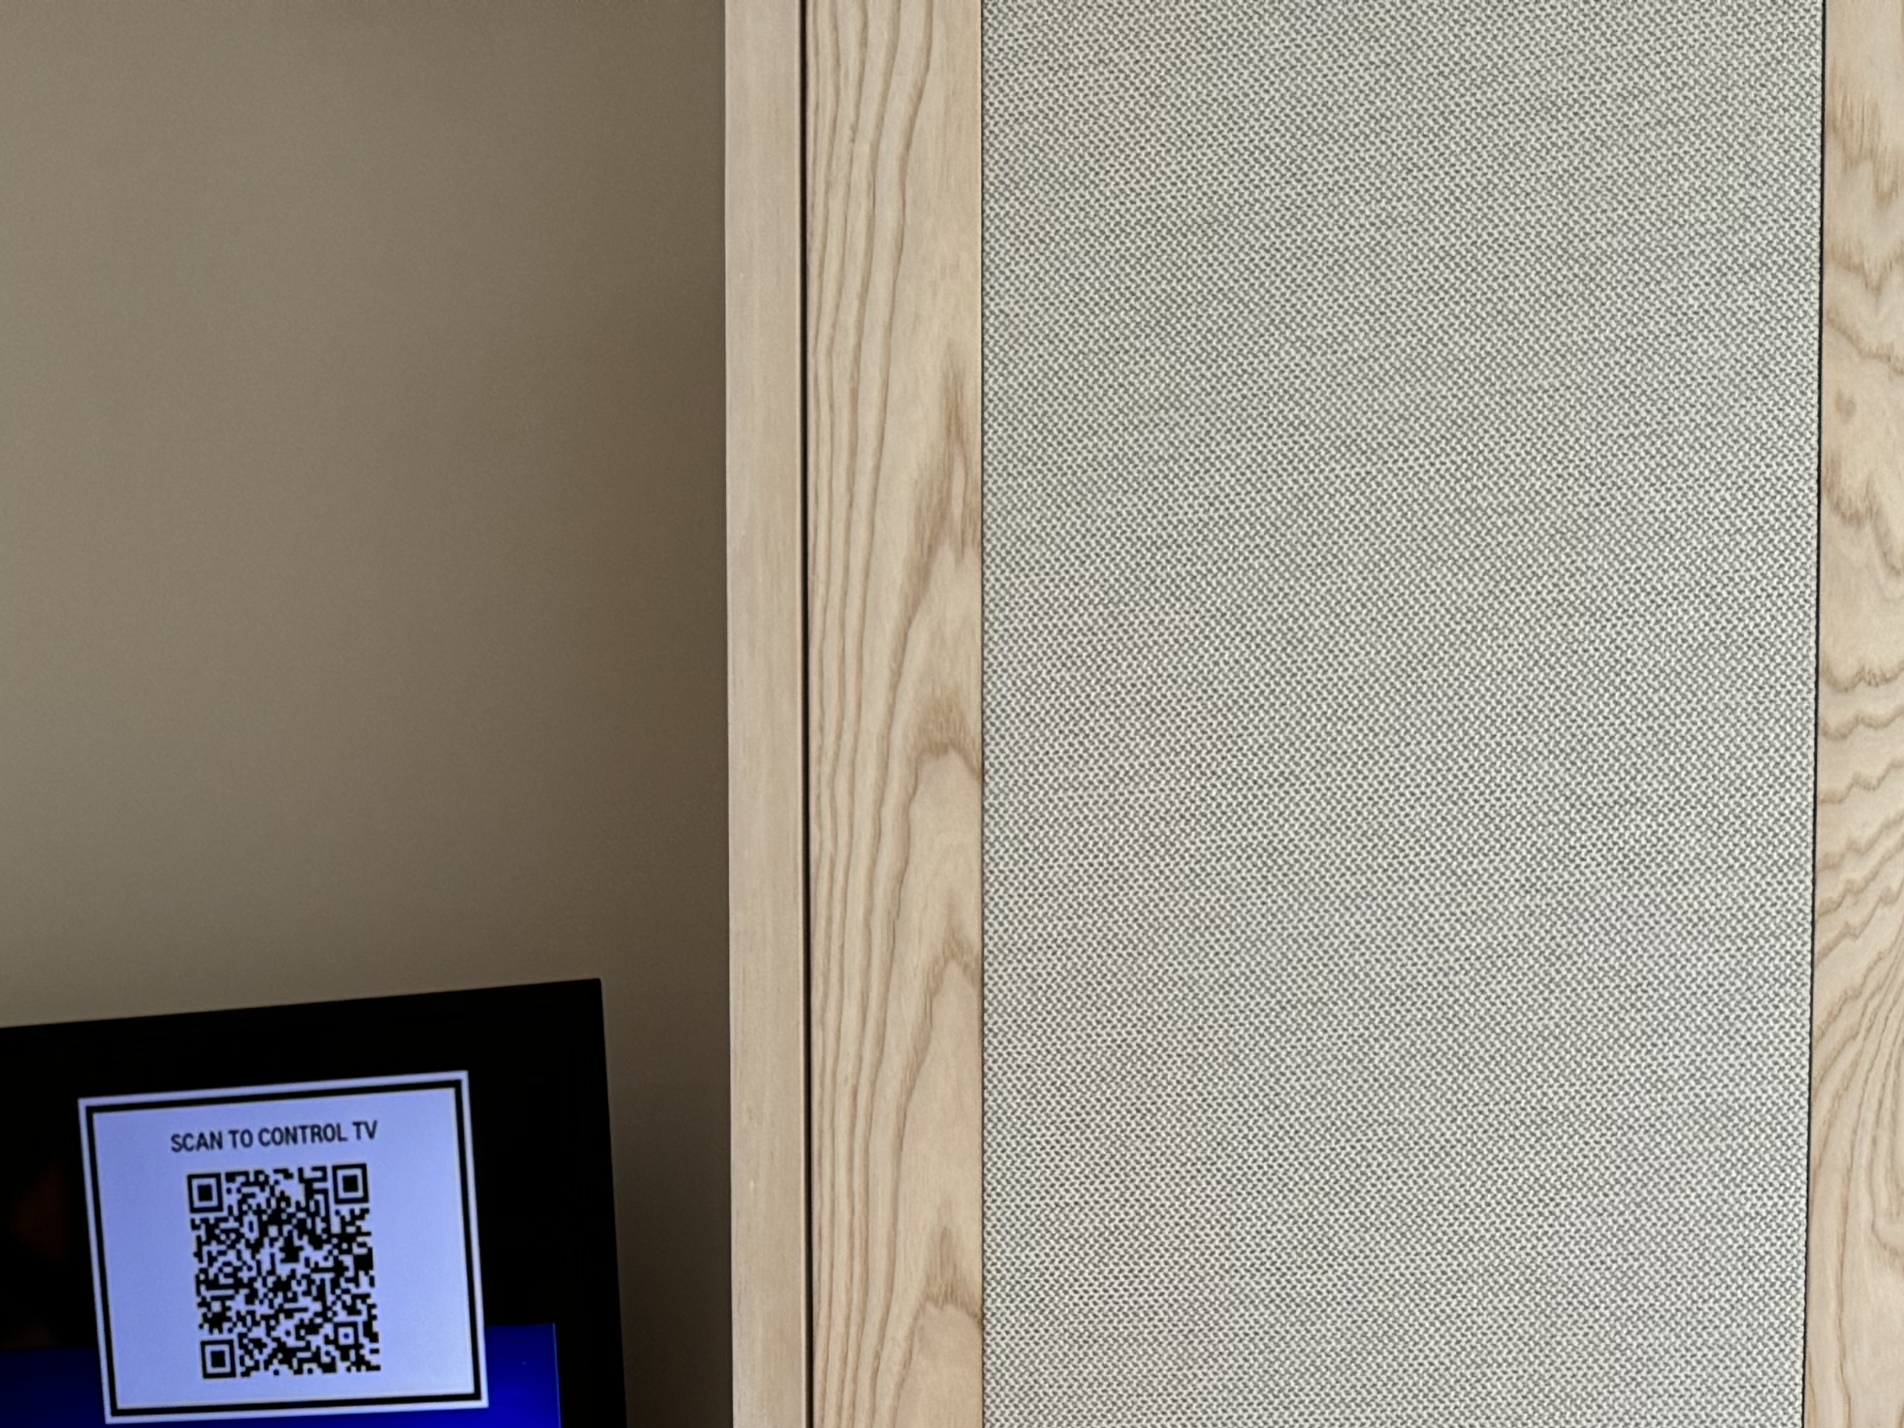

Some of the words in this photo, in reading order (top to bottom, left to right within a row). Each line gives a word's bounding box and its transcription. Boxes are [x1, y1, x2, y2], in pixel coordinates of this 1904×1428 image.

[171, 1130, 224, 1153] SCAN
[228, 1128, 254, 1149] TO
[258, 1122, 348, 1147] CONTROL
[352, 1120, 378, 1141] TV
